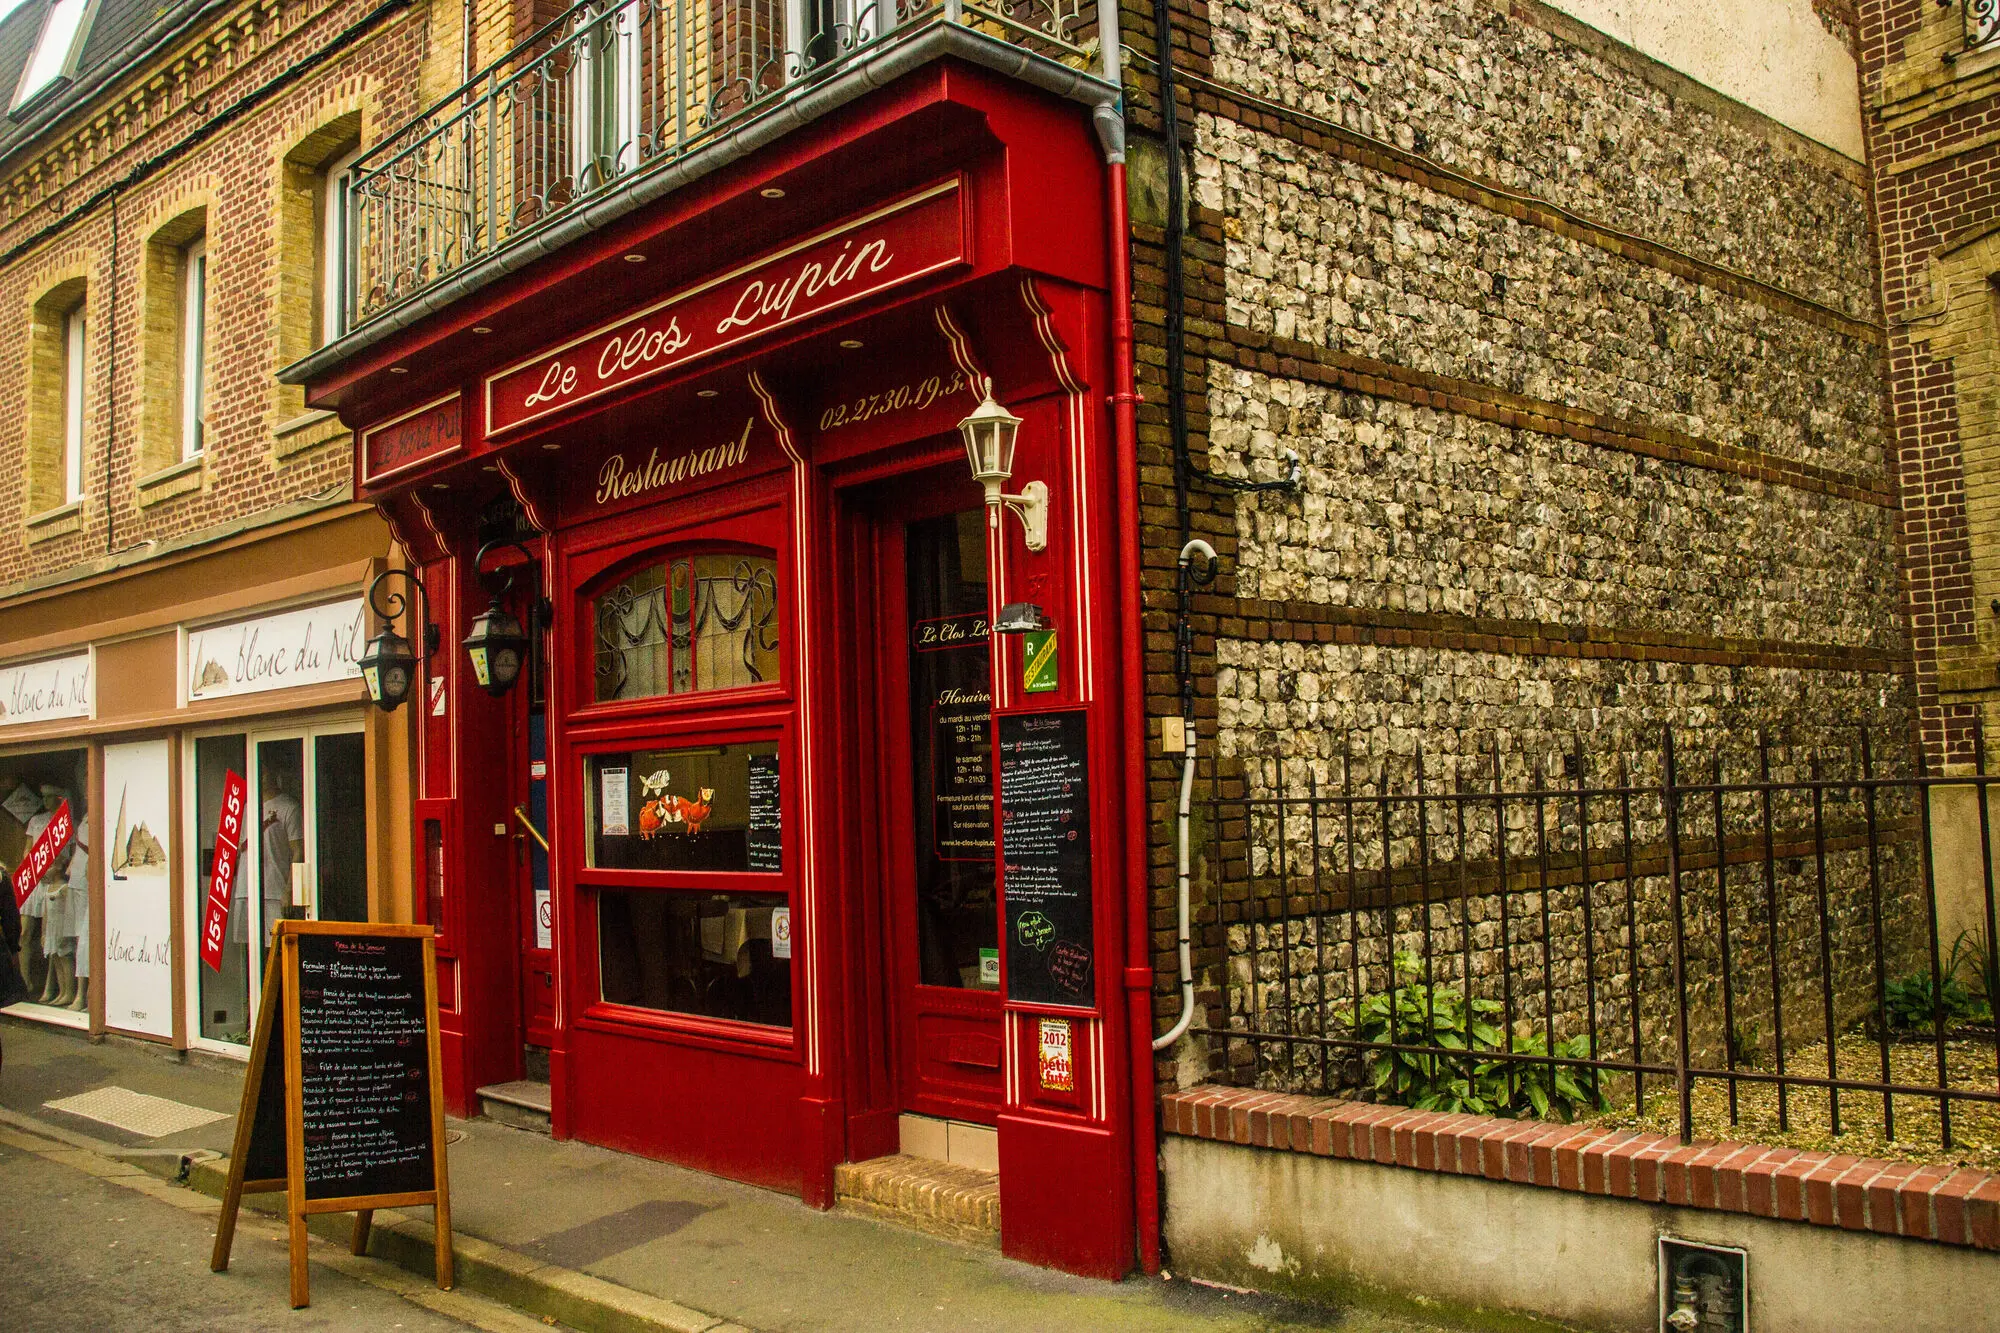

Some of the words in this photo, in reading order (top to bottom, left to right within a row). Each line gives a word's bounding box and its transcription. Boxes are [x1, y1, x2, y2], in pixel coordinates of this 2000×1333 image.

[525, 361, 577, 407] Le
[597, 316, 692, 379] Clos
[717, 238, 894, 334] Lupin
[596, 416, 755, 504] Restaurant
[294, 621, 320, 672] du
[328, 602, 364, 671] Nil
[920, 626, 937, 643] Le
[940, 623, 965, 642] Clos
[969, 620, 989, 640] Lu
[1027, 642, 1034, 655] R
[47, 670, 64, 709] du
[69, 663, 90, 708] Nil
[948, 715, 963, 723] mardi
[964, 714, 972, 722] au
[962, 755, 982, 763] samedi
[225, 783, 239, 835] 35€
[52, 813, 68, 845] 35€
[953, 821, 961, 829] Sur
[963, 820, 989, 828] réservation
[34, 842, 50, 871] 25€
[17, 867, 32, 895] 15€
[215, 848, 230, 899] 25€
[208, 908, 221, 952] 15€
[138, 934, 151, 963] du
[154, 935, 171, 967] Nil
[1044, 1032, 1066, 1046] 2012
[1041, 1059, 1071, 1072] petit
